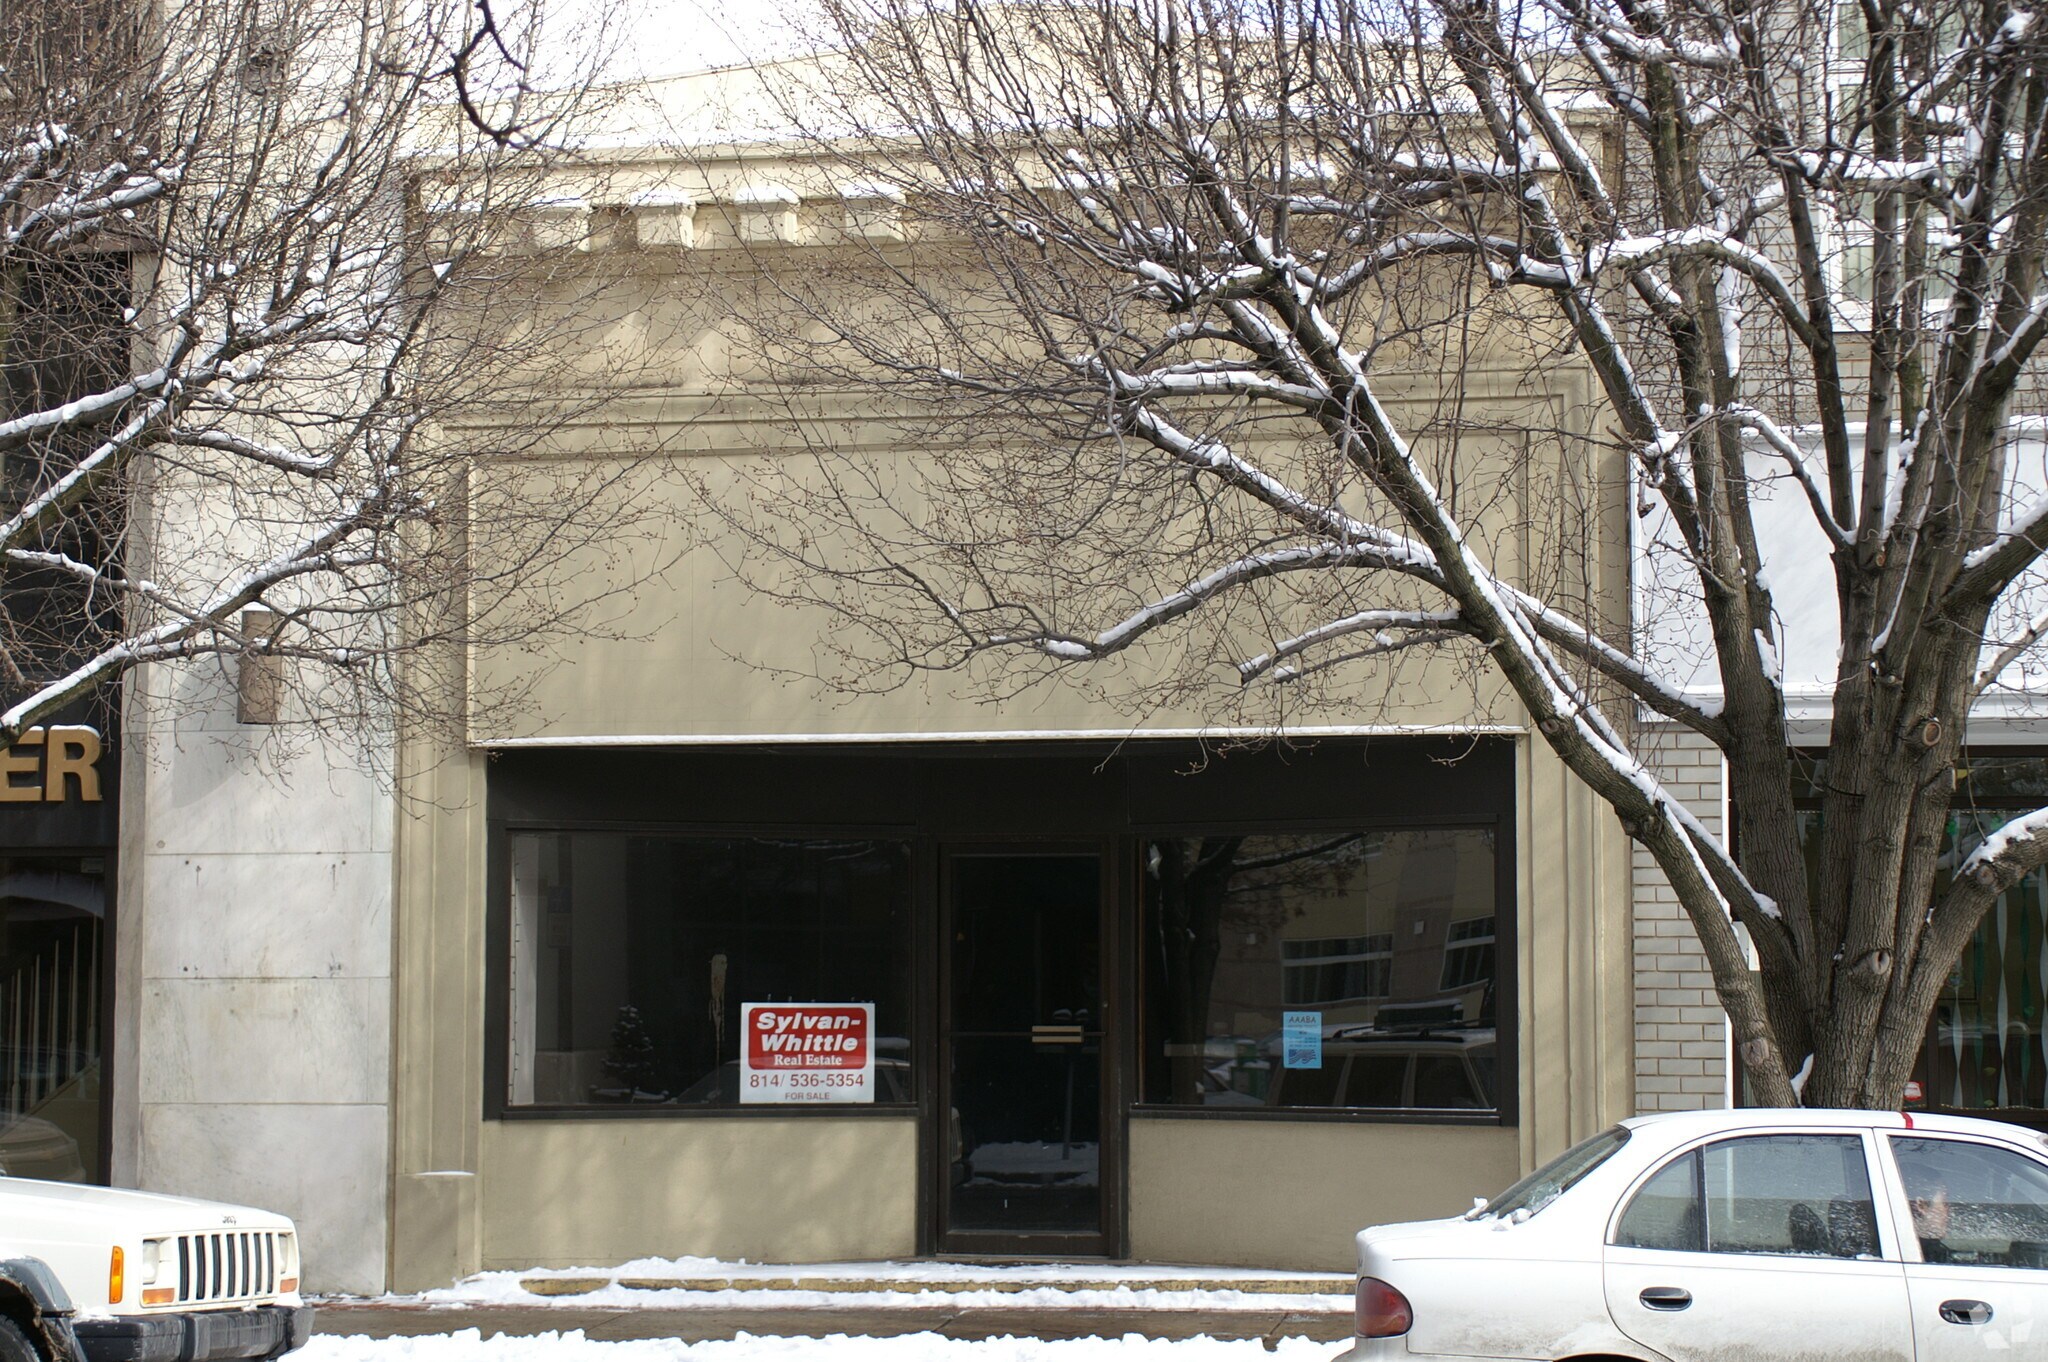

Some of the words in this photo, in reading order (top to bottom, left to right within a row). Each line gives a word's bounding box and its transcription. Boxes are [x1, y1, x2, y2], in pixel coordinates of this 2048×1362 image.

[0, 725, 103, 801] ER
[757, 1012, 861, 1033] Sylvan-
[761, 1034, 858, 1052] Whittle
[774, 1054, 802, 1066] Real
[806, 1054, 842, 1066] Estate
[750, 1073, 785, 1088] 814/
[790, 1073, 864, 1088] 536-5354
[785, 1092, 804, 1101] FOR
[806, 1092, 830, 1101] SALE
